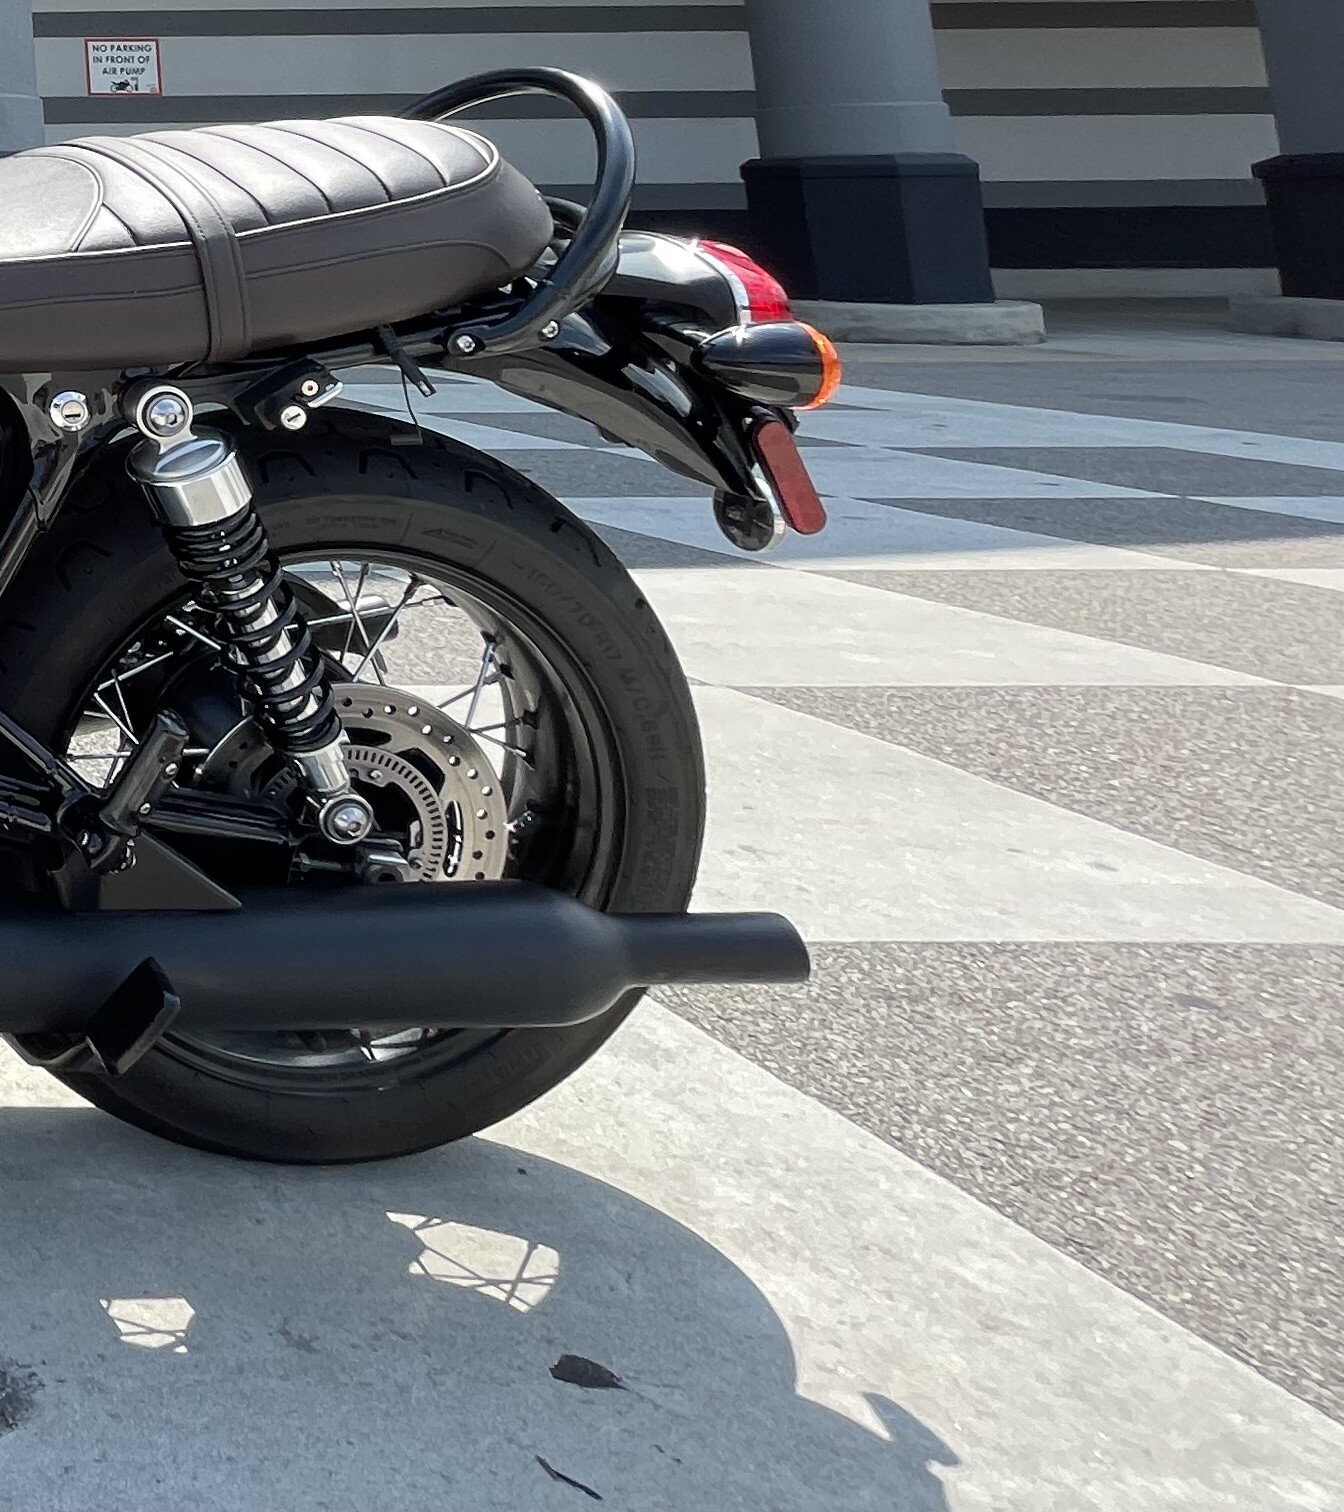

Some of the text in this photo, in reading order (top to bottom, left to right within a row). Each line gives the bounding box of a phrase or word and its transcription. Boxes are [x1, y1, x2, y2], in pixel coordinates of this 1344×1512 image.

[92, 44, 152, 52] NO PARKING
[105, 56, 135, 64] FRONT
[137, 56, 150, 64] OF
[102, 67, 145, 75] AIR PUMP
